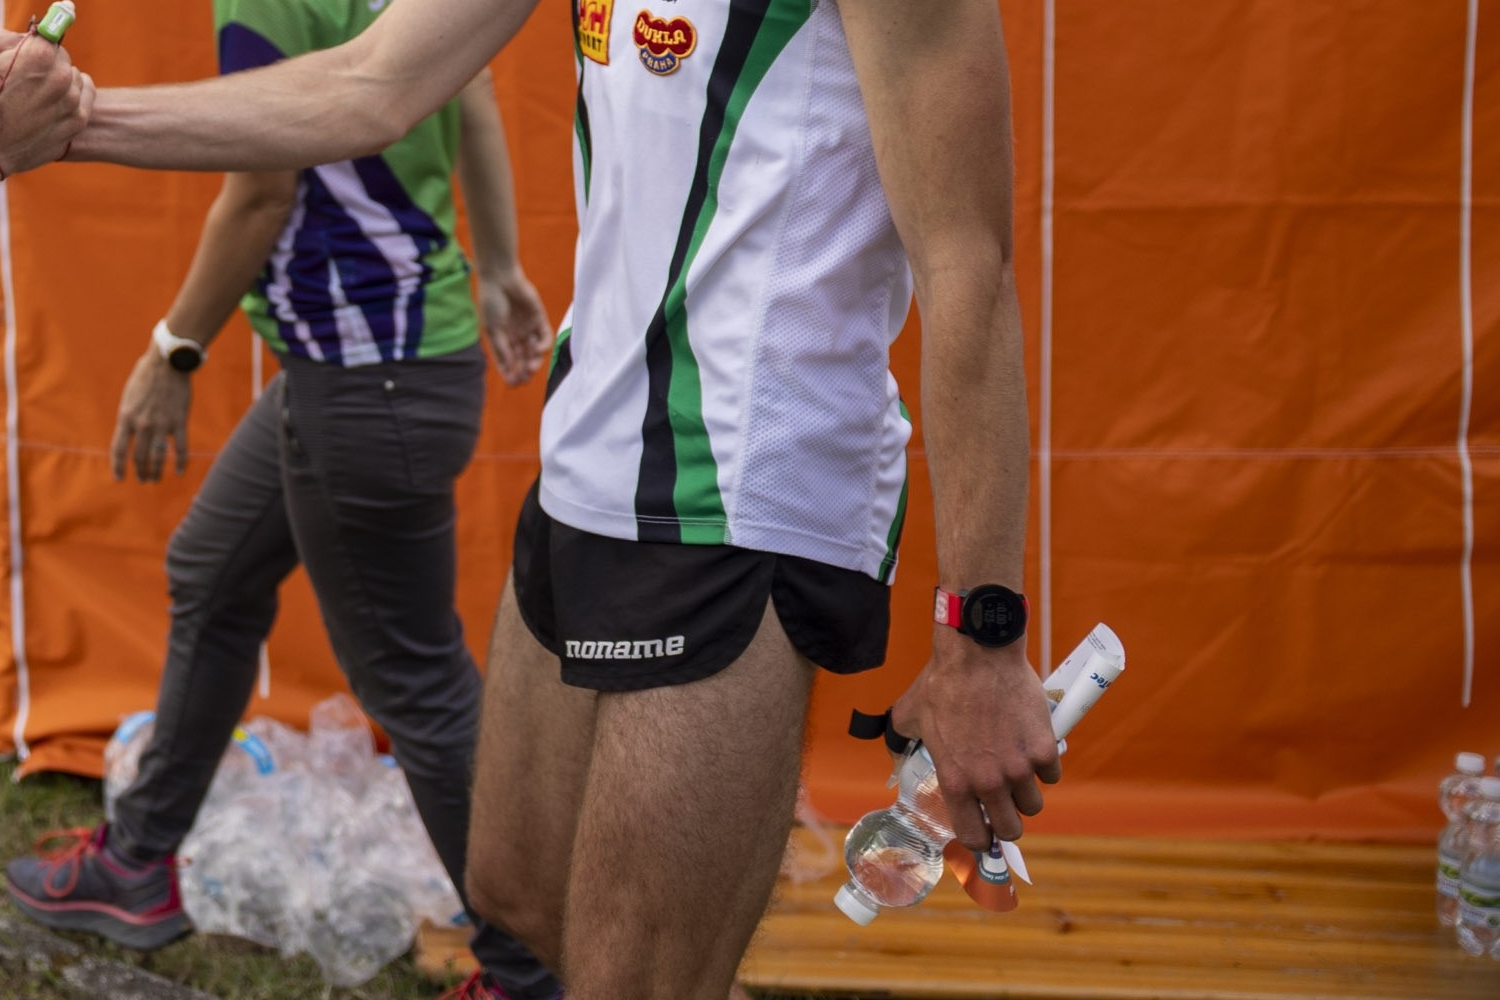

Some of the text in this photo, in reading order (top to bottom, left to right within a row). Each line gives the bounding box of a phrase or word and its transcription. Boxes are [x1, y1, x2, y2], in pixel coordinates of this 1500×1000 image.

[637, 16, 687, 45] DUKLA
[642, 51, 674, 70] PRAHA
[565, 635, 685, 659] noname
